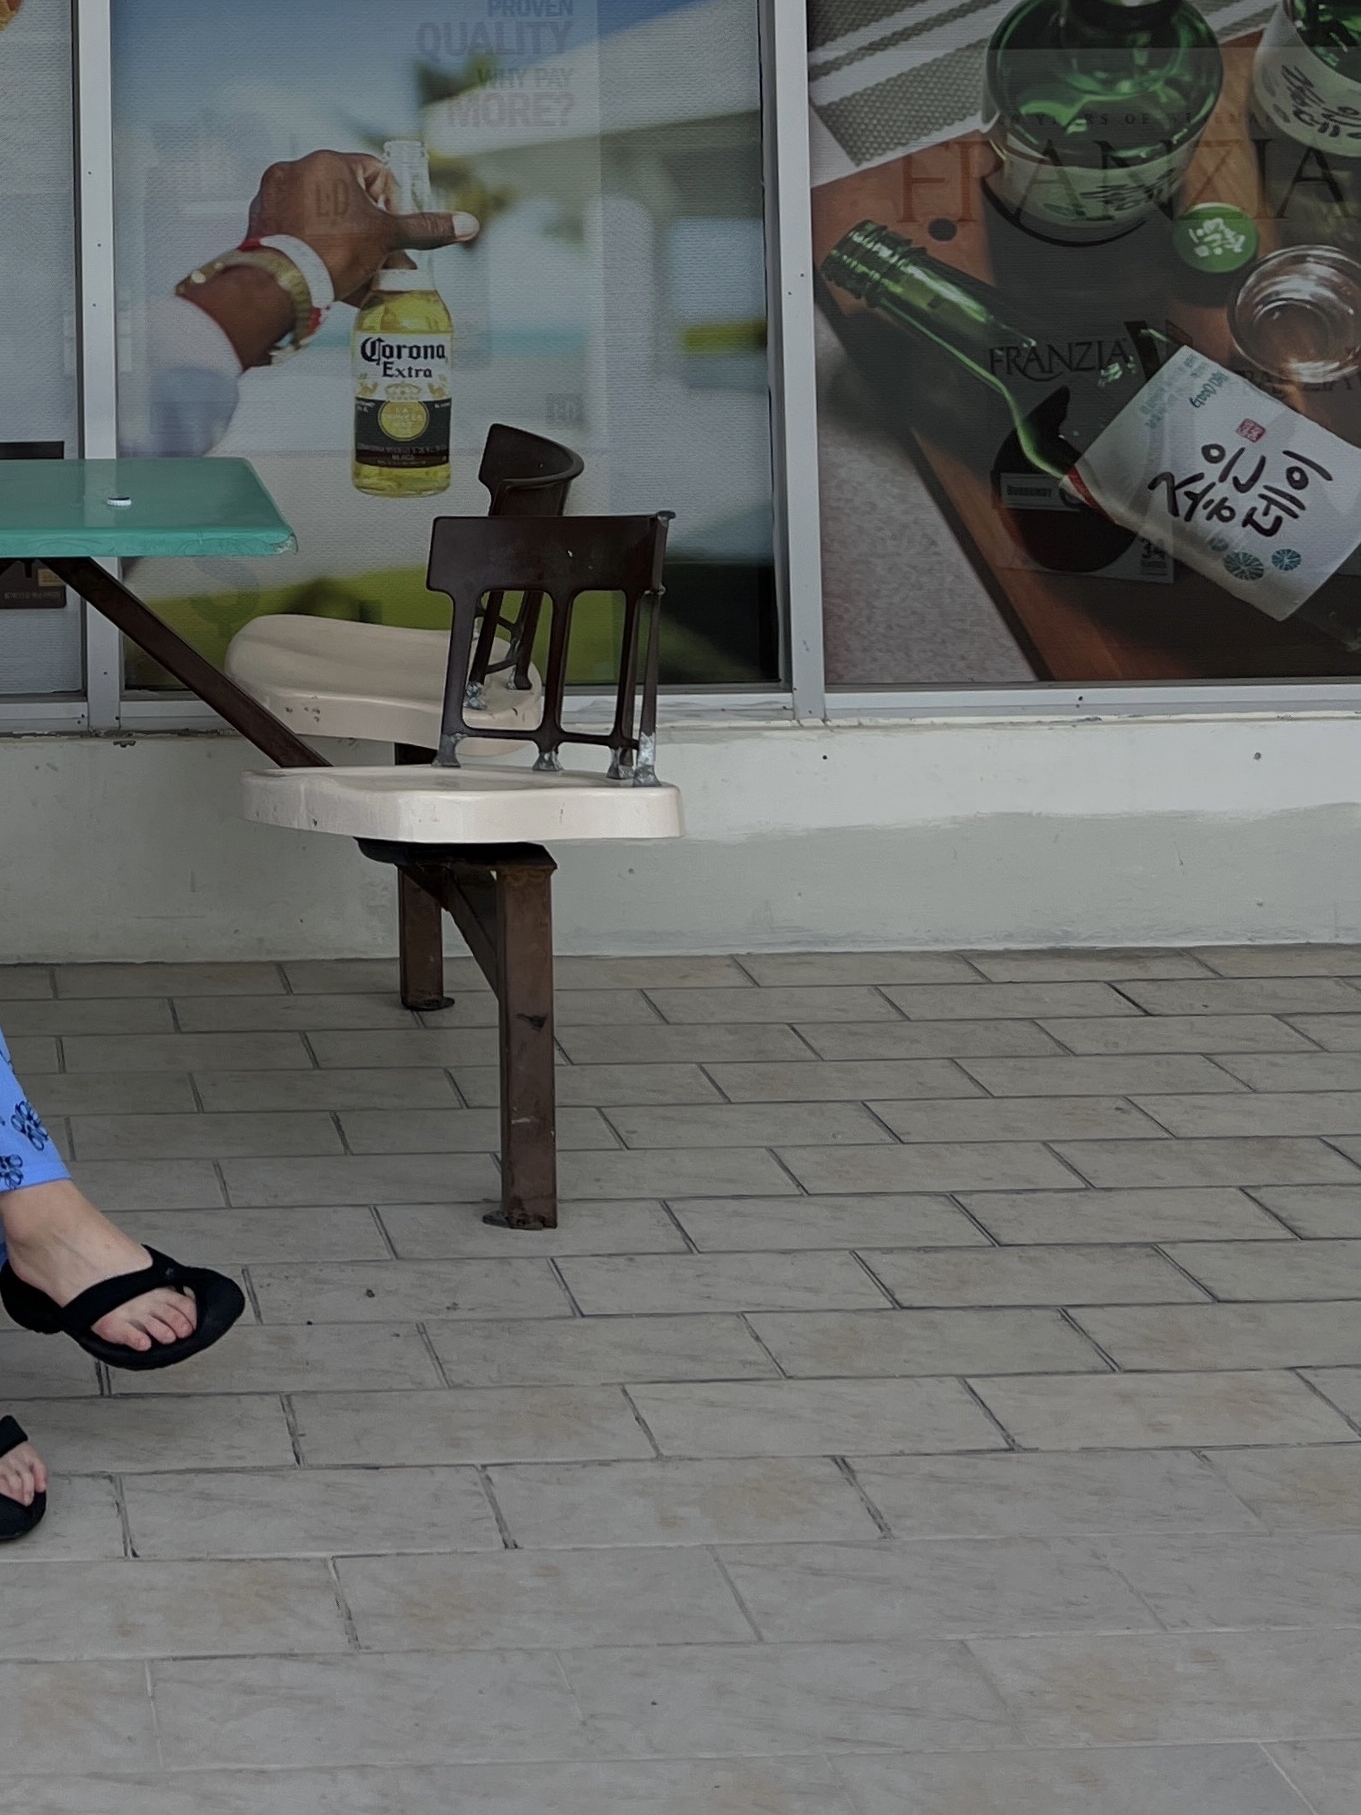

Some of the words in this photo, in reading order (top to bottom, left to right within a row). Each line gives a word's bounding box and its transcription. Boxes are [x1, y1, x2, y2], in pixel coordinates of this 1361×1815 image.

[416, 20, 573, 57] QUALITY
[477, 67, 527, 87] WHY
[532, 67, 574, 87] PAY
[445, 92, 574, 127] MORE?
[898, 137, 1349, 231] FRANZIA
[360, 336, 446, 366] Corona
[989, 338, 1130, 382] FRANZIA
[382, 360, 433, 379] Extra
